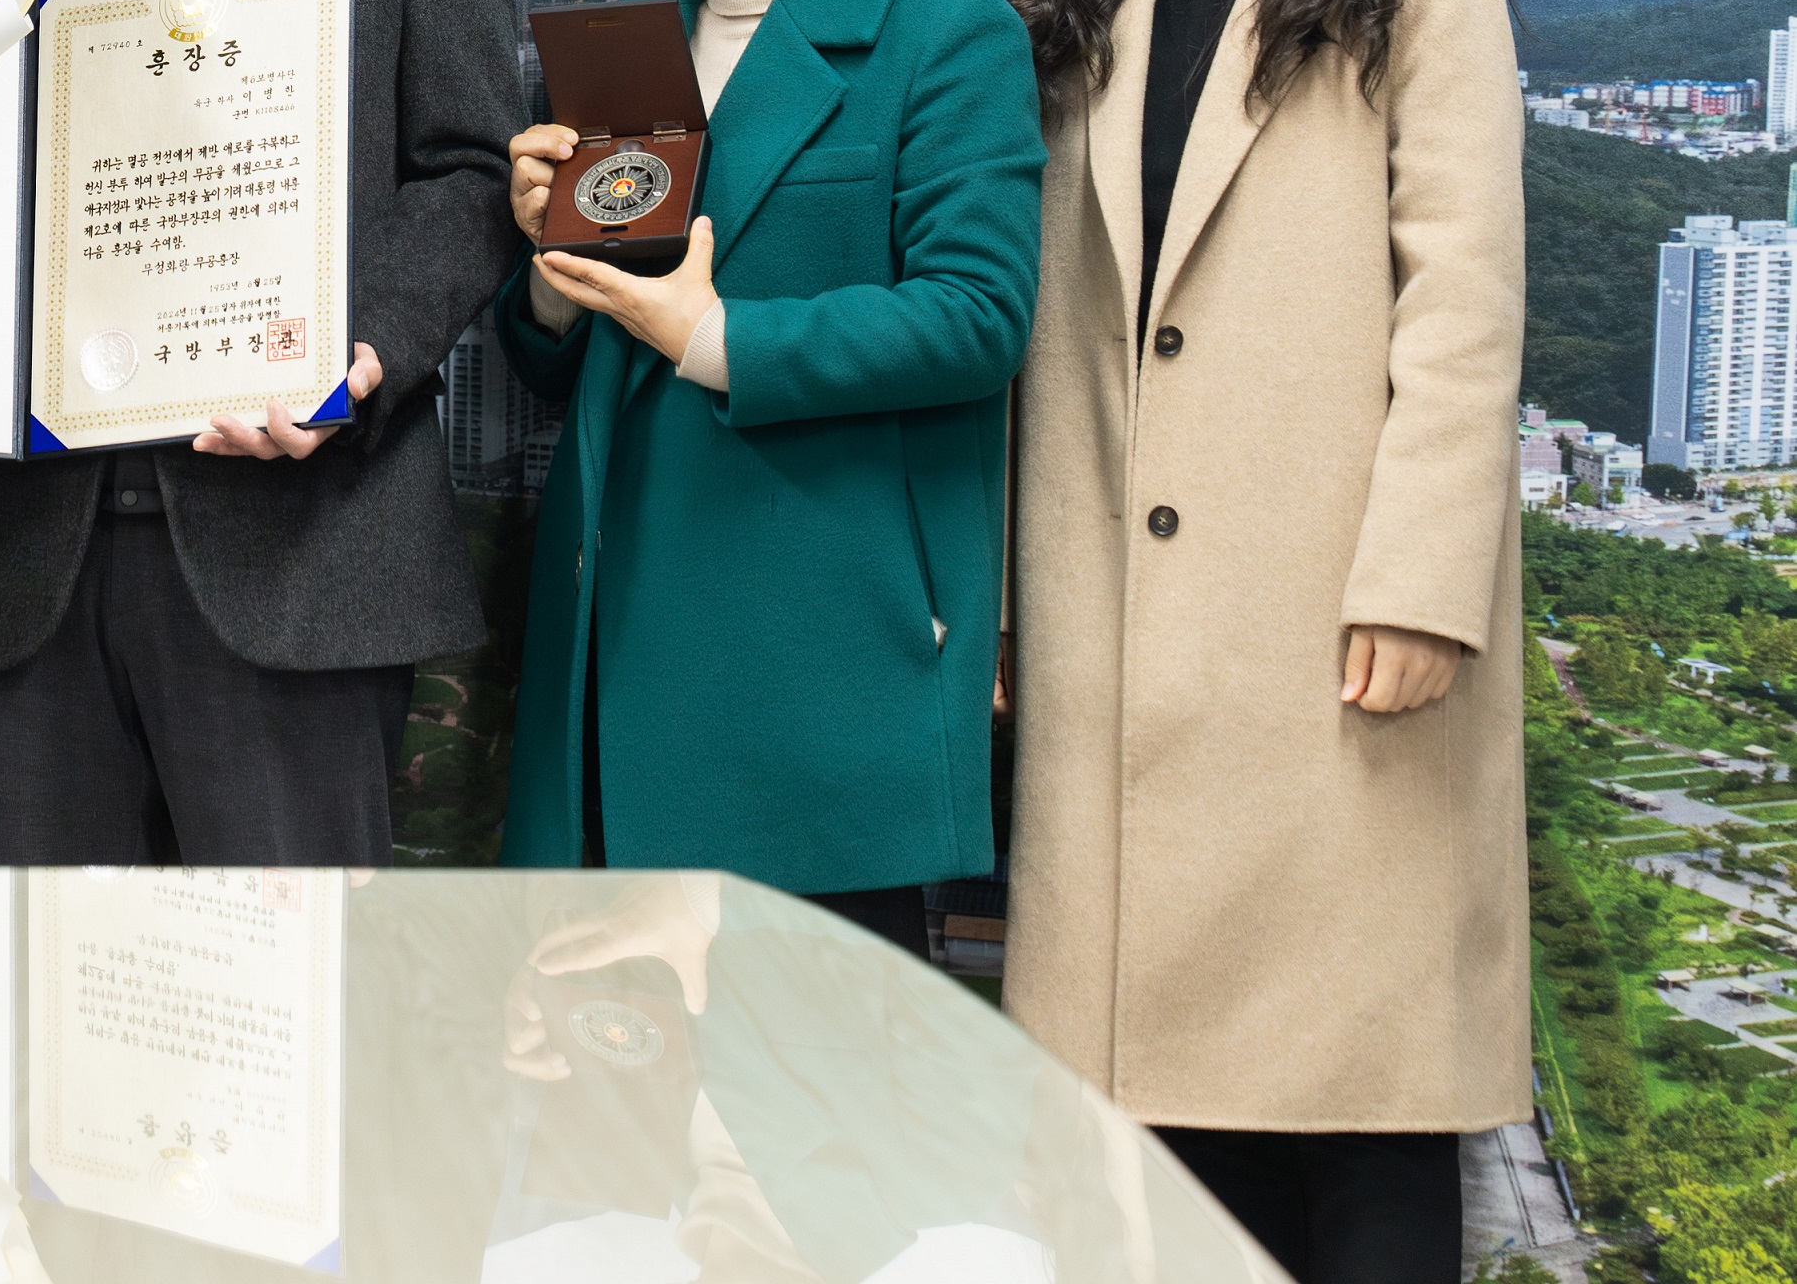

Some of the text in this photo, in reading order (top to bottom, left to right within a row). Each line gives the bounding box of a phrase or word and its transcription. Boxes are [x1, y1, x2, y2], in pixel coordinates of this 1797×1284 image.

[92, 134, 300, 173] 귀하는 멸공 전선에서 제반 애로를 극복하고
[85, 156, 300, 195] 헌신 분투 하여 발군의 무공을 세웠으므로 그
[84, 176, 300, 217] 애국지성과 빛나는 공적을 높이 기려 대통령 내훈
[84, 198, 299, 238] 제2호에 따른 국방부장관의 권한에 의하여
[83, 235, 186, 260] 다음 훈장을 수여함.
[141, 251, 240, 276] 무성화랑 무공훈장
